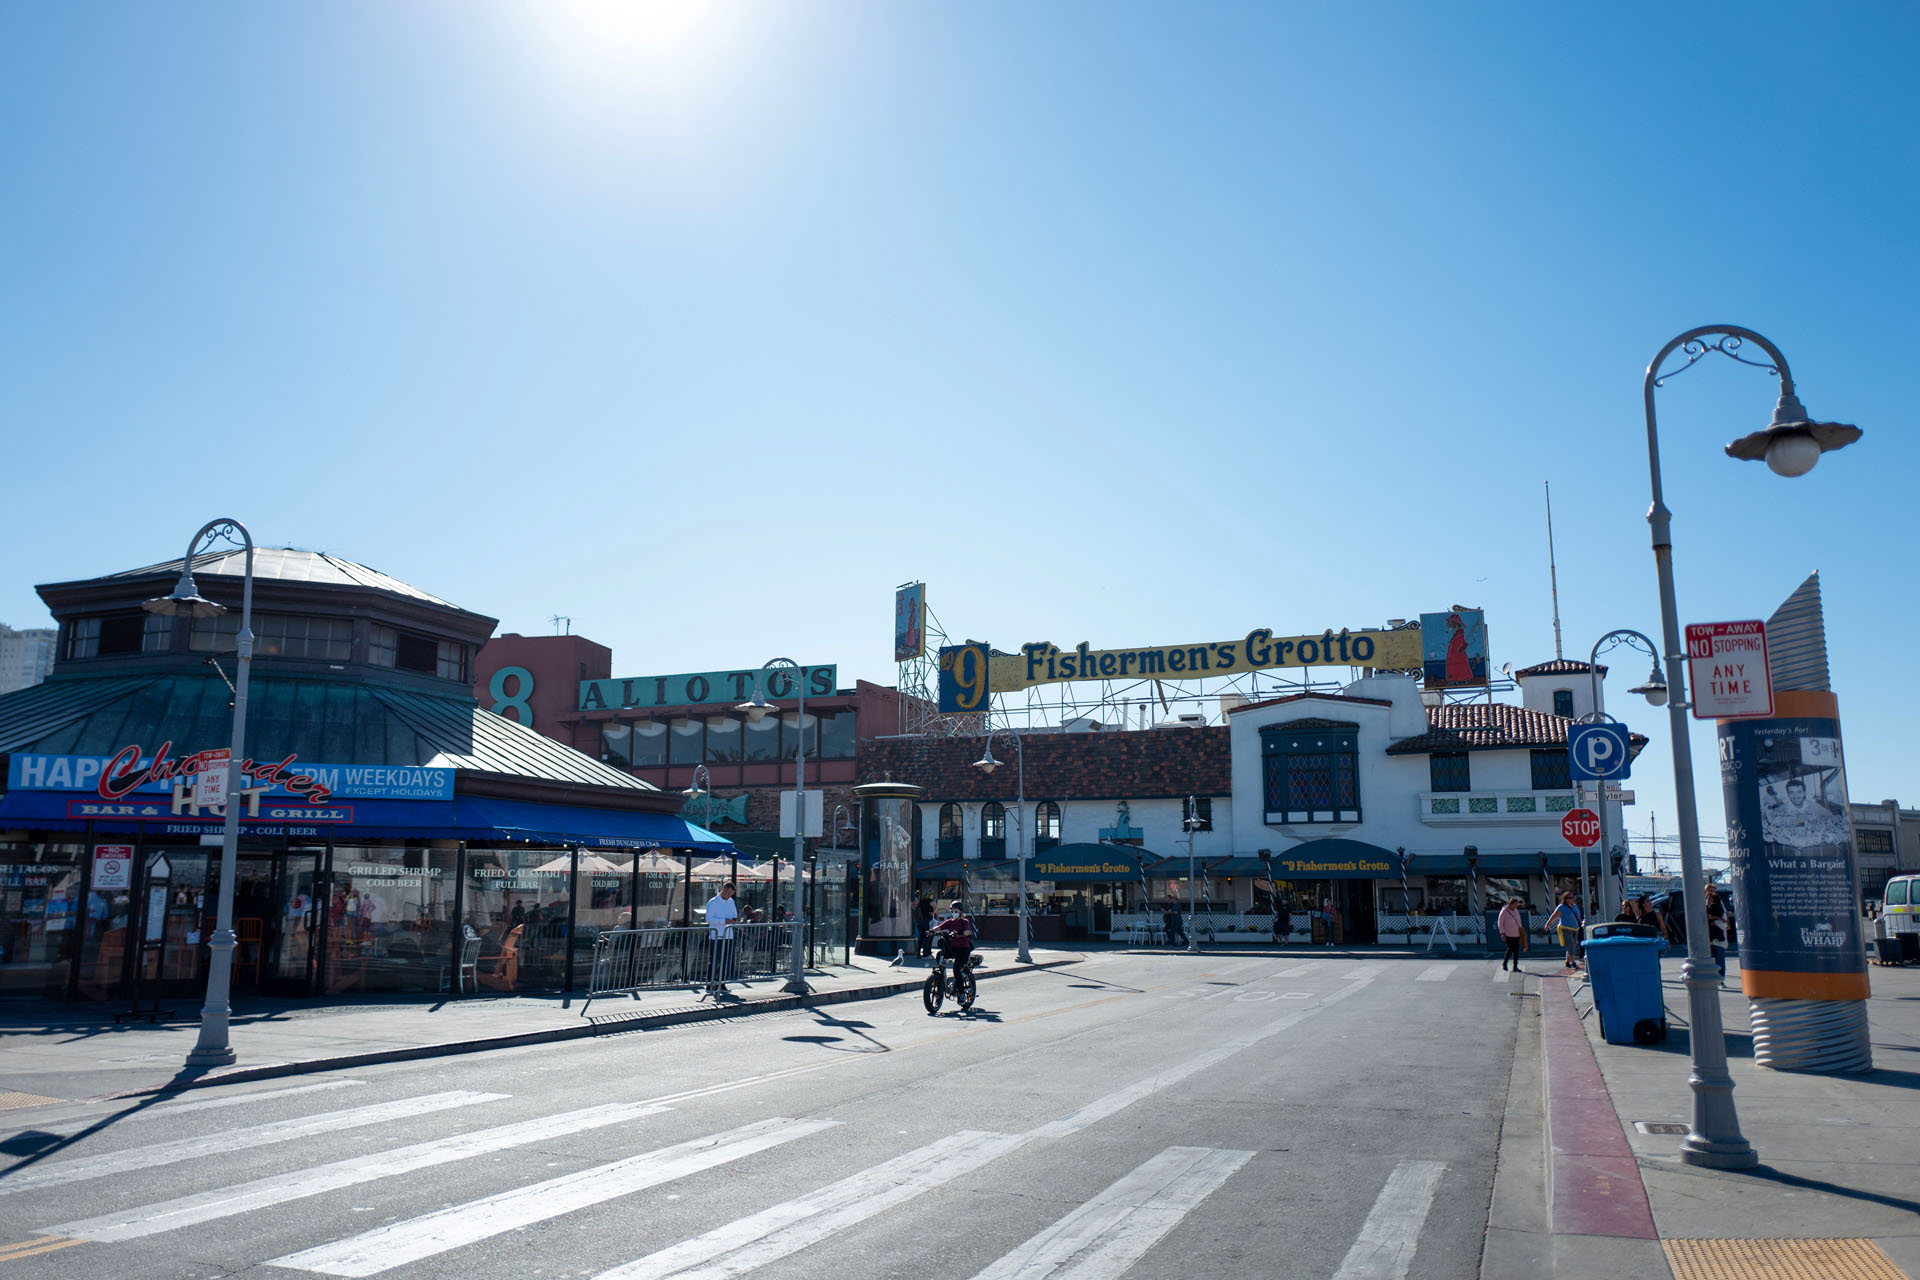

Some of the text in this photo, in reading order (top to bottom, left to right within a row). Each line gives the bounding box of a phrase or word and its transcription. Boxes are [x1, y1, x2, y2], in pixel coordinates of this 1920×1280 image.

[1691, 627, 1714, 636] TOW
[1726, 623, 1759, 633] AWAY
[1690, 638, 1760, 656] NO STOPPING
[1026, 628, 1375, 680] Fishermen's Grotto
[1713, 664, 1745, 678] ANY
[954, 646, 986, 709] 9
[581, 668, 833, 709] ALIOTO'S
[1710, 680, 1752, 695] TIME
[489, 666, 535, 728] 8
[1754, 727, 1792, 735] Yesterday's
[346, 768, 444, 787] WEEKDAYS
[205, 785, 220, 793] TIME
[391, 788, 442, 797] HOLIDAYS
[81, 805, 344, 819] BAR & GRILL
[167, 825, 200, 833] FRIED
[289, 827, 317, 835] BEER
[1564, 821, 1598, 836] STOP
[15, 864, 59, 874] TACOS
[1040, 863, 1046, 873] 9
[1048, 862, 1101, 873] Fishermen's
[1102, 862, 1130, 873] Grotto
[1289, 862, 1295, 871] 9
[1296, 860, 1357, 871] Fishermen's
[1358, 859, 1390, 871] Grotto
[1768, 859, 1846, 871] What a Bargain!
[349, 866, 441, 876] GRILLED SHRIMP
[474, 869, 560, 878] FRIED CALAMARI
[25, 878, 48, 886] BAR
[366, 879, 422, 888] COLD BEER
[517, 881, 539, 889] BAR
[591, 880, 620, 888] COLD BEER
[648, 881, 663, 889] COLD
[1800, 928, 1846, 936] Fisherman's
[1801, 936, 1847, 946] WHARF
